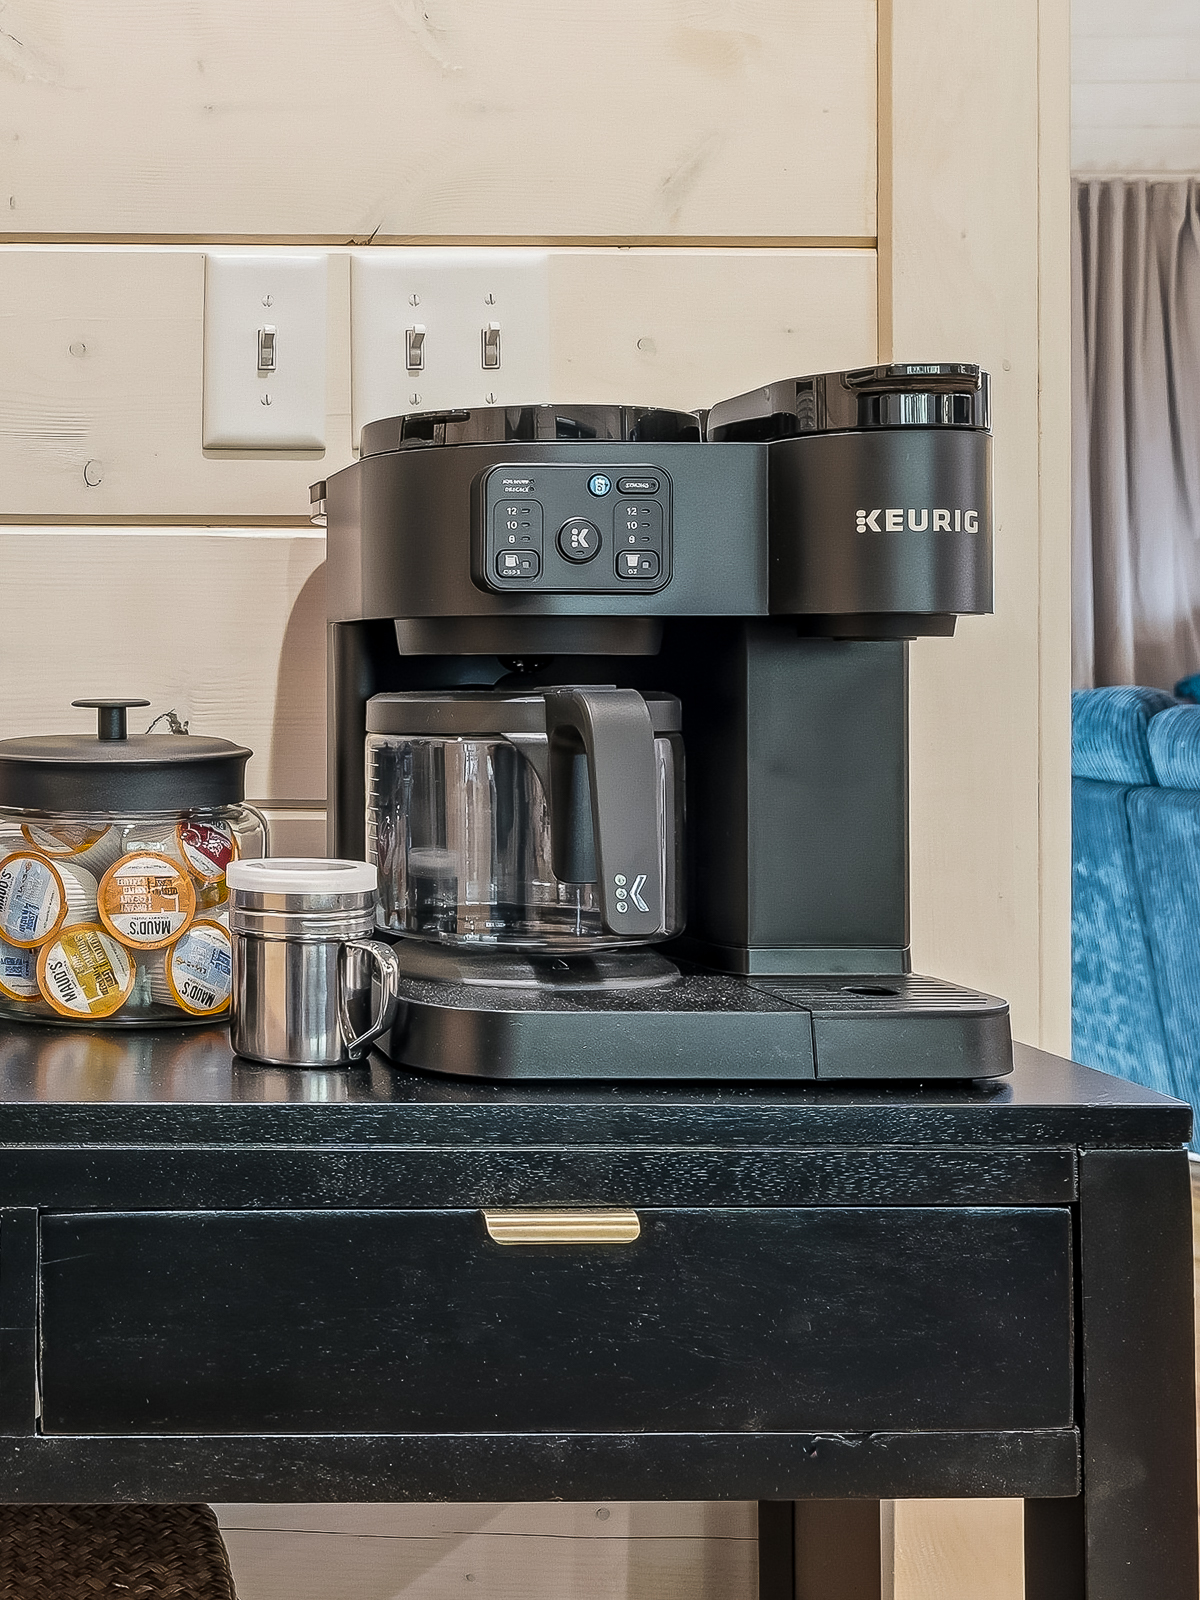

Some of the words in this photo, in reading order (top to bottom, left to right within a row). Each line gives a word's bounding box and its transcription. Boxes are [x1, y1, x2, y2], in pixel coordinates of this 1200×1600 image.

[506, 507, 518, 515] 12
[626, 507, 638, 515] 12
[506, 521, 518, 529] 10
[626, 521, 638, 529] 10
[855, 508, 979, 534] KEURIG
[129, 920, 171, 935] MAUD'S
[49, 960, 79, 1004] MAUD'S
[184, 980, 217, 1007] MAUD'S
